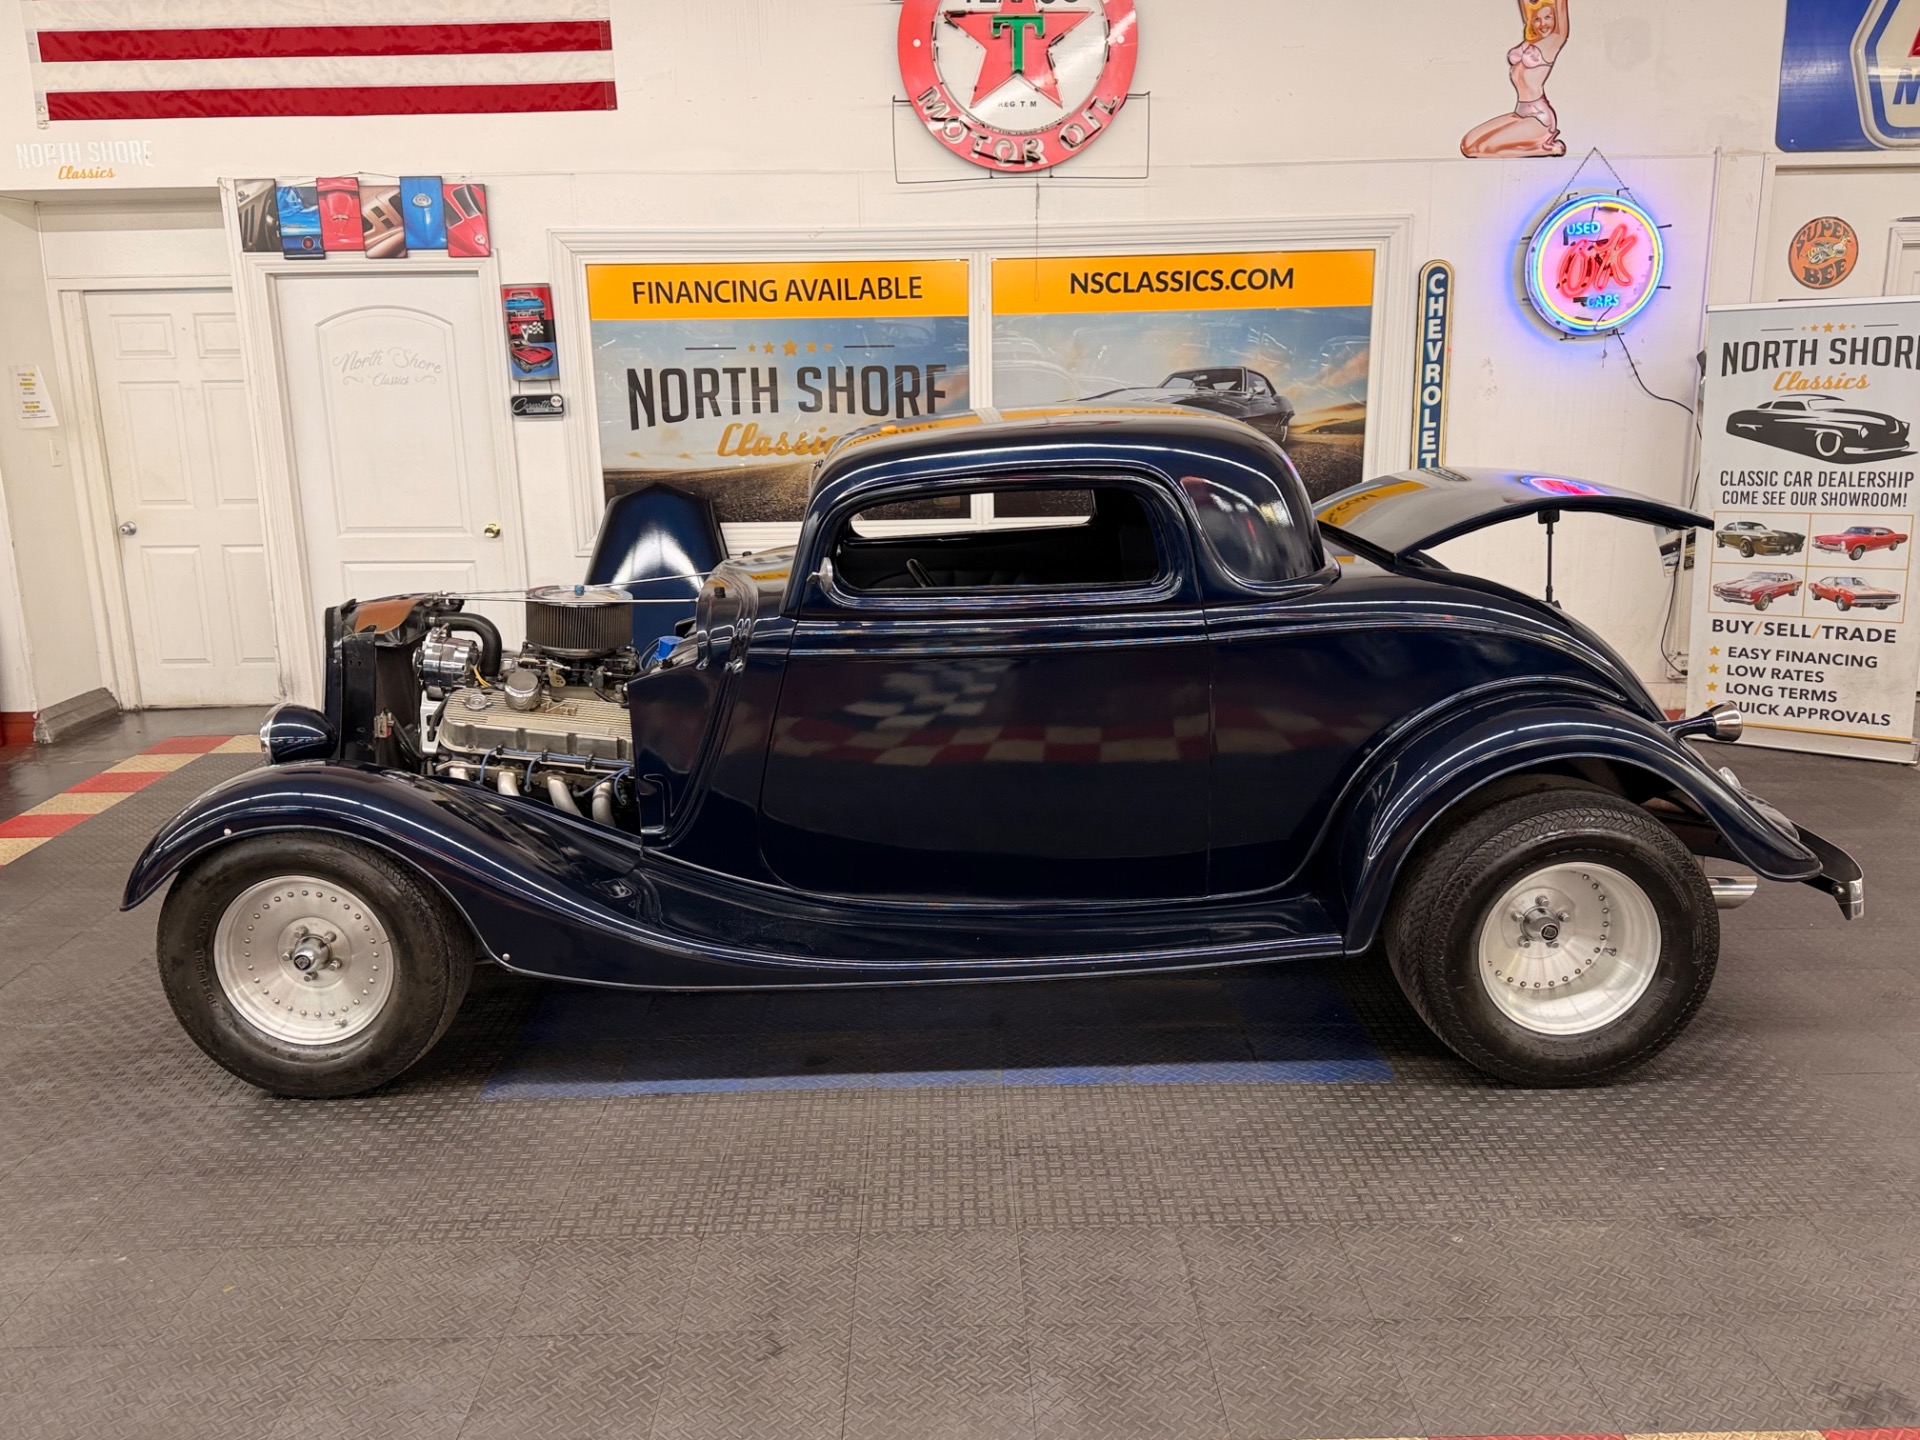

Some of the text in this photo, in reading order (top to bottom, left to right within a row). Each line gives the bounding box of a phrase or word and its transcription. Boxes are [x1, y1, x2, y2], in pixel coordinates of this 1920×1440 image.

[917, 86, 1121, 167] MOTOR OIL
[15, 140, 154, 170] NORTH SHORE
[58, 165, 116, 180] Classics
[1566, 221, 1601, 235] USED
[1796, 220, 1851, 260] SUPER
[1557, 223, 1638, 298] OK
[1803, 259, 1847, 285] BEE
[632, 276, 923, 304] FINANCING AVAILABLE
[1070, 267, 1294, 295] NSCLASSICS.COM
[1586, 294, 1620, 308] CARS
[332, 346, 444, 374] North Shore
[1721, 338, 1819, 377] NORTH
[368, 372, 409, 387] Classics
[1421, 272, 1446, 469] CHEVROLET
[1773, 370, 1870, 391] Classics
[626, 366, 780, 431] NORTH
[1720, 470, 1914, 488] CLASSIC CAR DEALERSHIP
[1722, 490, 1907, 508] COME SEE OUR SHOWROOM!
[1711, 618, 1896, 643] BUY/SELL/TRADE
[1727, 646, 1878, 669] EASY FINANCING
[1726, 664, 1825, 683] LOW RATES
[1725, 682, 1838, 703] LONG TERMS
[1783, 705, 1891, 726] APPROVALS
